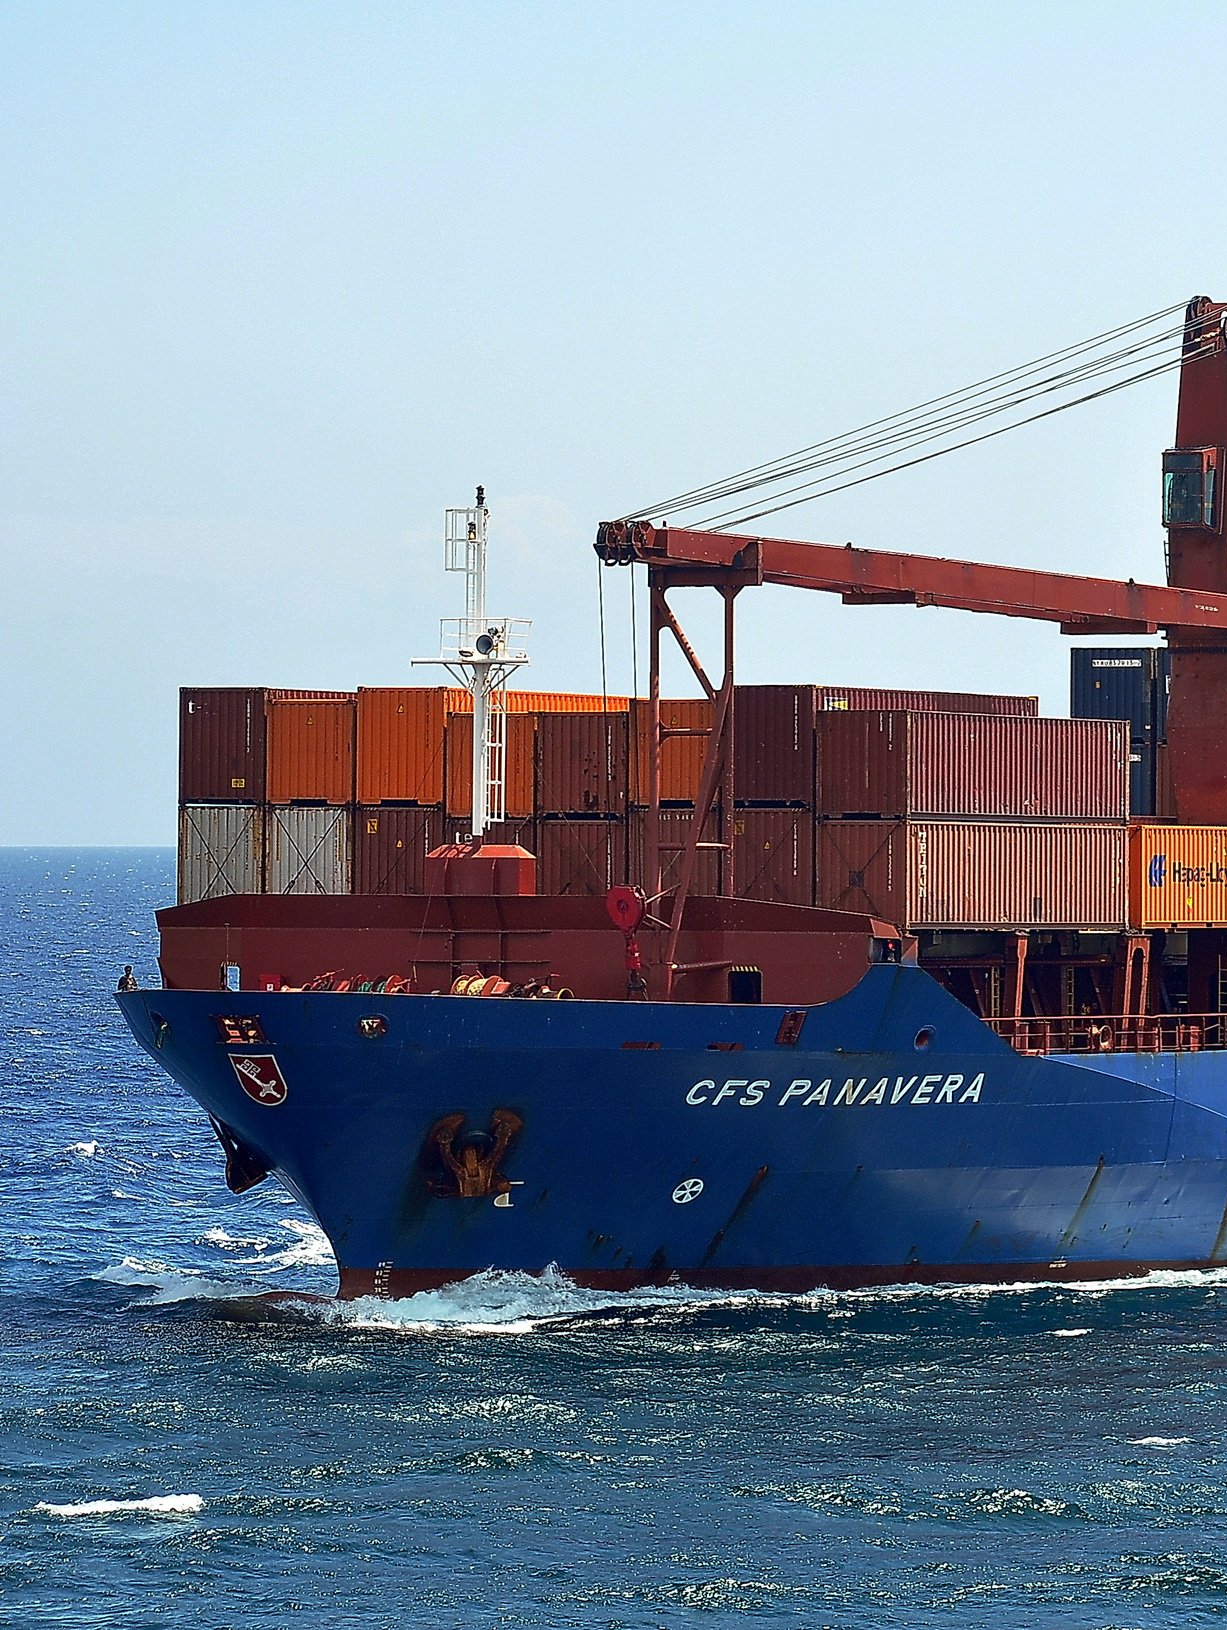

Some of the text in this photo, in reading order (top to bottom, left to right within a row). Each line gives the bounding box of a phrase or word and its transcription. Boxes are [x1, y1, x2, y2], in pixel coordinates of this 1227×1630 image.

[455, 832, 473, 845] te
[685, 1072, 986, 1106] CFS PANAVERA
